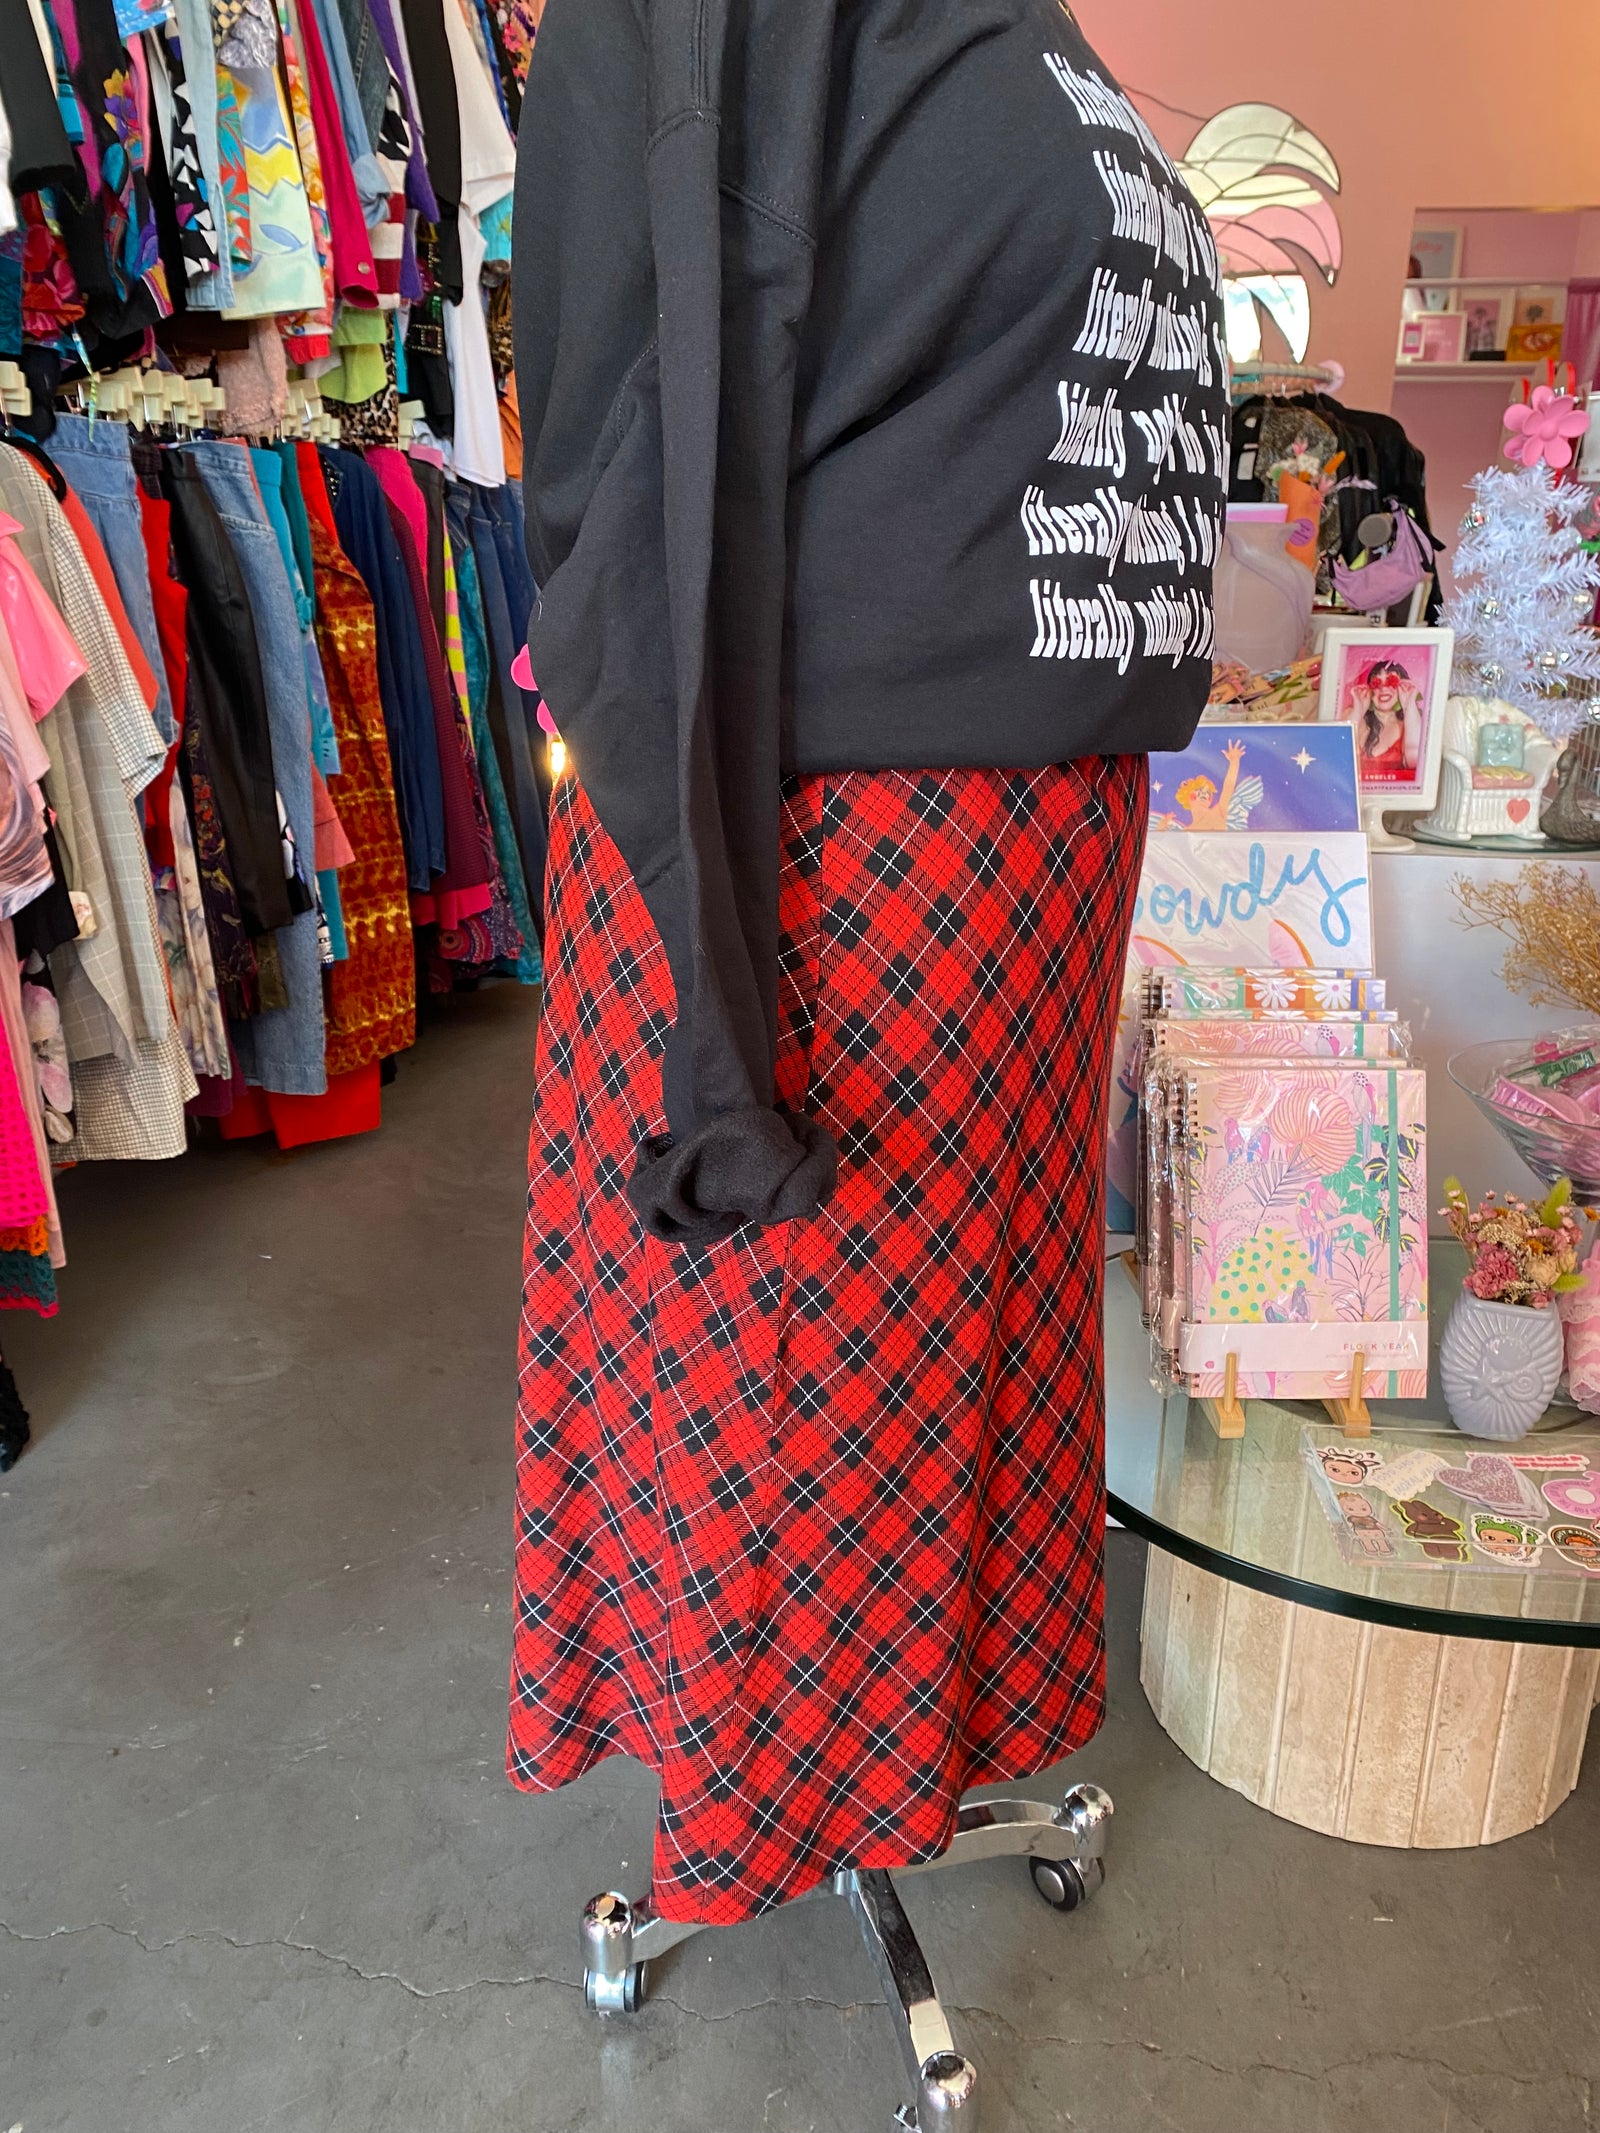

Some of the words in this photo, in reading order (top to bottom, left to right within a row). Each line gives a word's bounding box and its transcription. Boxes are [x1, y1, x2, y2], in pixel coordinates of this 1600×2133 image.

[1092, 150, 1163, 269] literally
[1072, 266, 1157, 380] literally
[1047, 380, 1126, 479] literally
[1020, 484, 1134, 578] literally
[1028, 578, 1136, 676] literally
[1133, 842, 1368, 948] owdy
[1343, 1343, 1378, 1351] FLOCK
